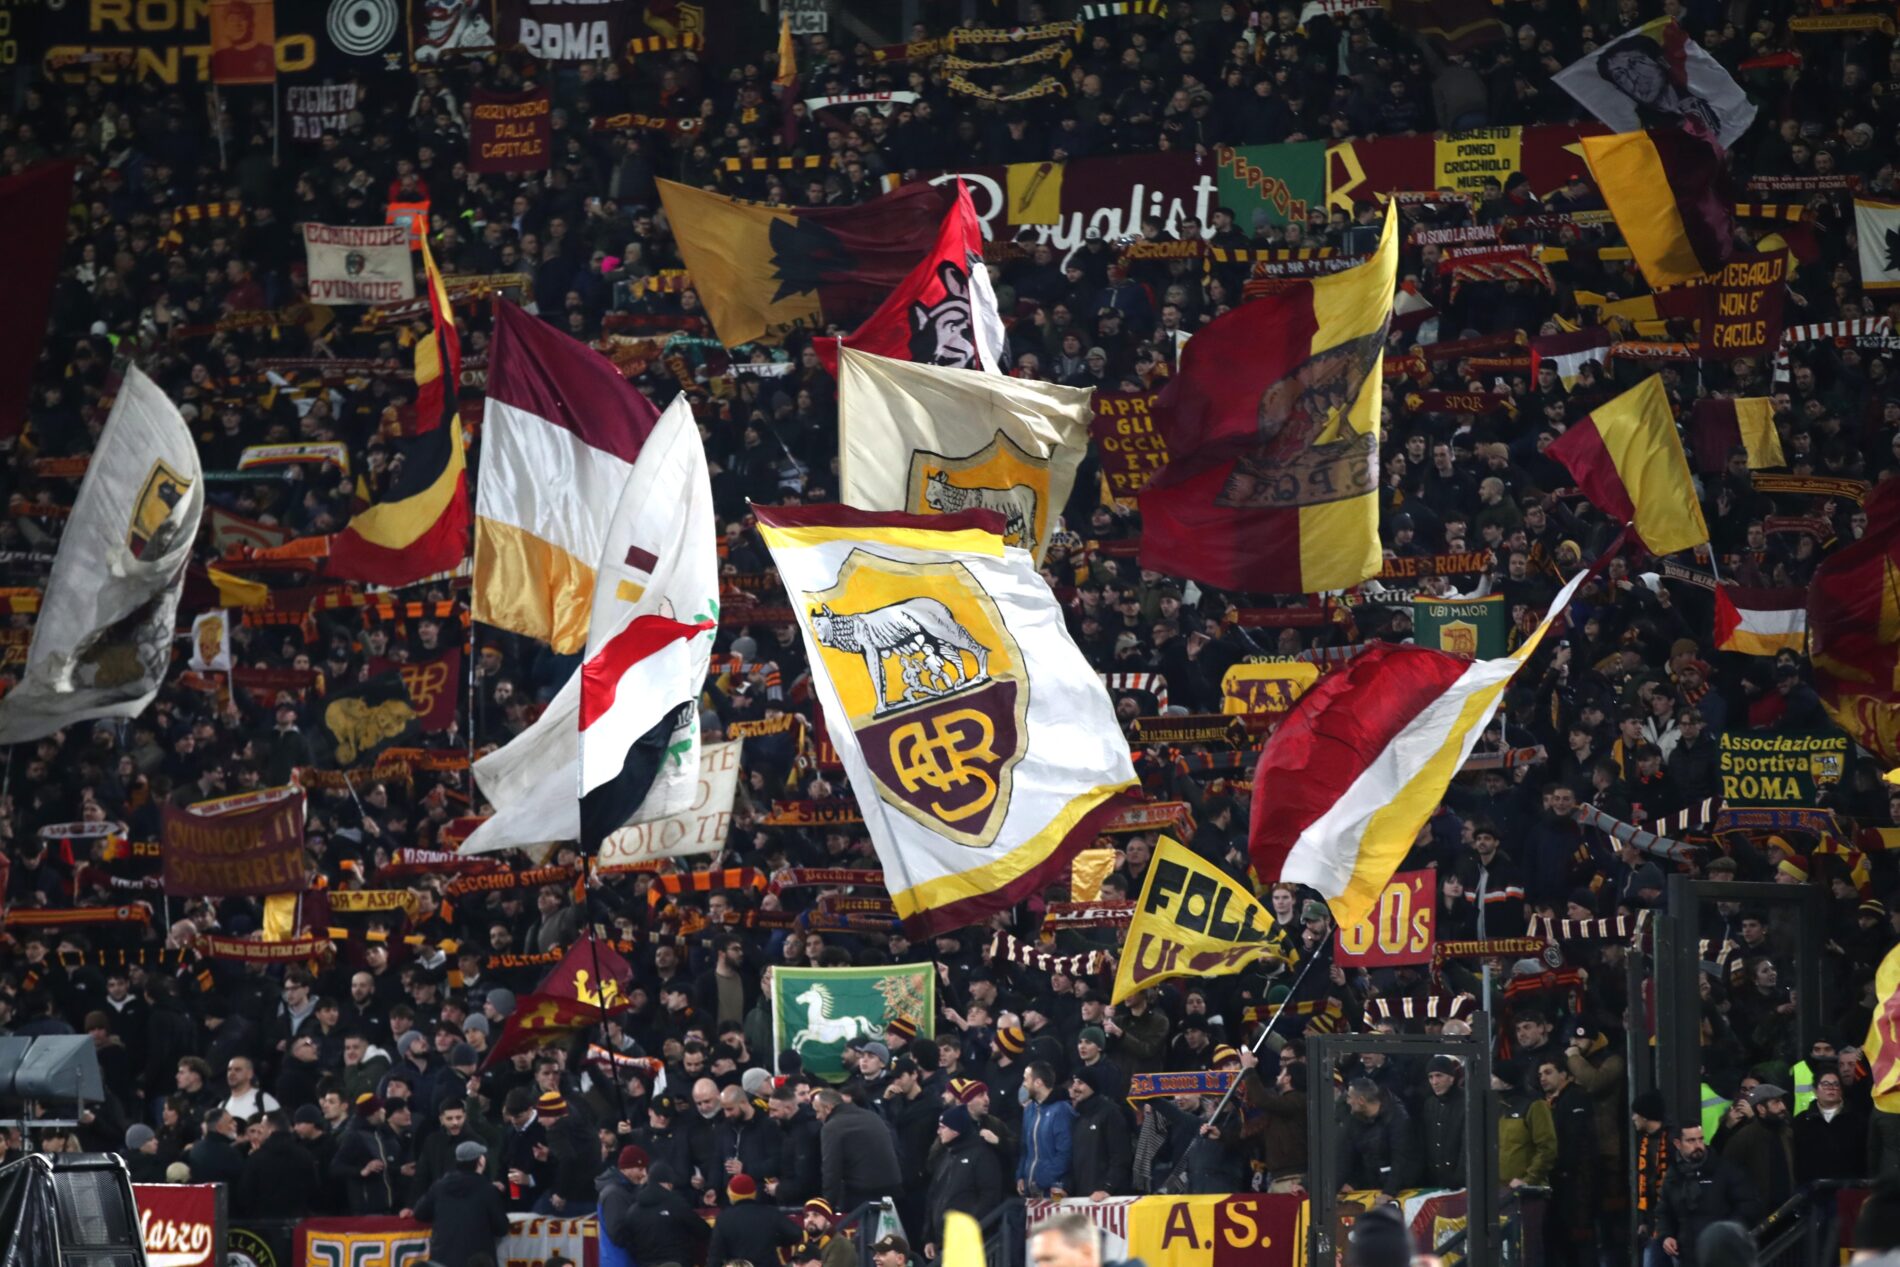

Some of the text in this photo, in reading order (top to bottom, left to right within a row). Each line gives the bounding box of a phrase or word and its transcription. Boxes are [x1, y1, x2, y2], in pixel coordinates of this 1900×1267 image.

[519, 18, 611, 60] ROMA
[473, 99, 549, 119] ARRIVEREMO
[495, 121, 535, 138] DALLA
[482, 139, 542, 157] CAPITALE
[1457, 144, 1495, 157] PONGO
[1444, 159, 1510, 174] CRICCHIOLO
[1427, 229, 1454, 244] SONO
[1467, 225, 1496, 241] ROMA
[309, 280, 403, 300] OVUNQUE
[1719, 292, 1746, 316] NON
[1713, 320, 1767, 348] FACILE
[1446, 396, 1484, 411] SPQR
[1117, 416, 1153, 435] GLI
[1125, 454, 1139, 470] E
[1429, 606, 1488, 617] UBI MAIOR
[1720, 732, 1848, 751] Associazione
[1720, 752, 1809, 775] Sportiva
[1722, 775, 1803, 800] ROMA
[448, 873, 514, 897] VECCHIO
